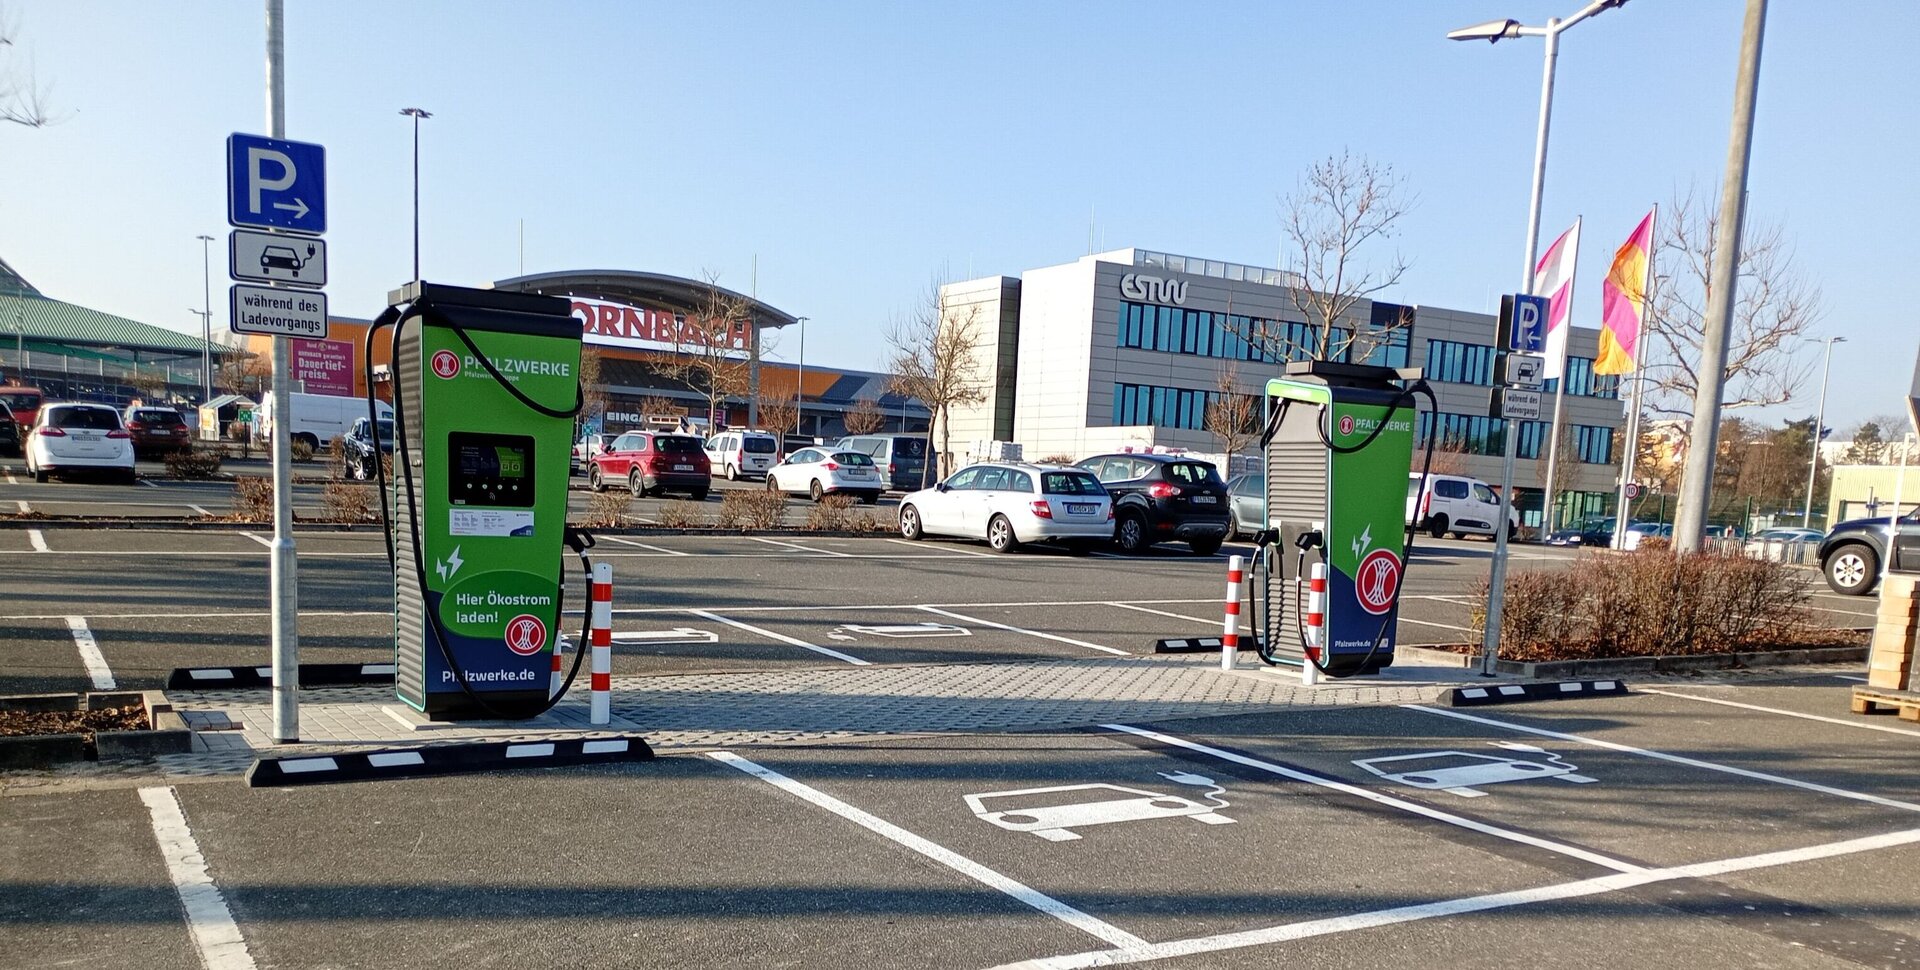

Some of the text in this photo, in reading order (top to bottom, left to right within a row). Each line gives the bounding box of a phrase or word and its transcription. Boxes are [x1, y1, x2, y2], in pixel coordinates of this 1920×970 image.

[248, 147, 296, 214] P
[1121, 273, 1188, 304] ESTW
[244, 294, 318, 313] während des
[242, 311, 321, 333] Ladevorgangs
[1517, 302, 1539, 343] P
[298, 357, 346, 371] Dauertief-
[464, 355, 570, 377] PFLZWERKE
[298, 369, 330, 380] preise.
[456, 590, 551, 606] Hier Ökostrom
[456, 611, 499, 623] laden!
[442, 668, 536, 683] Pflzwerke.de
